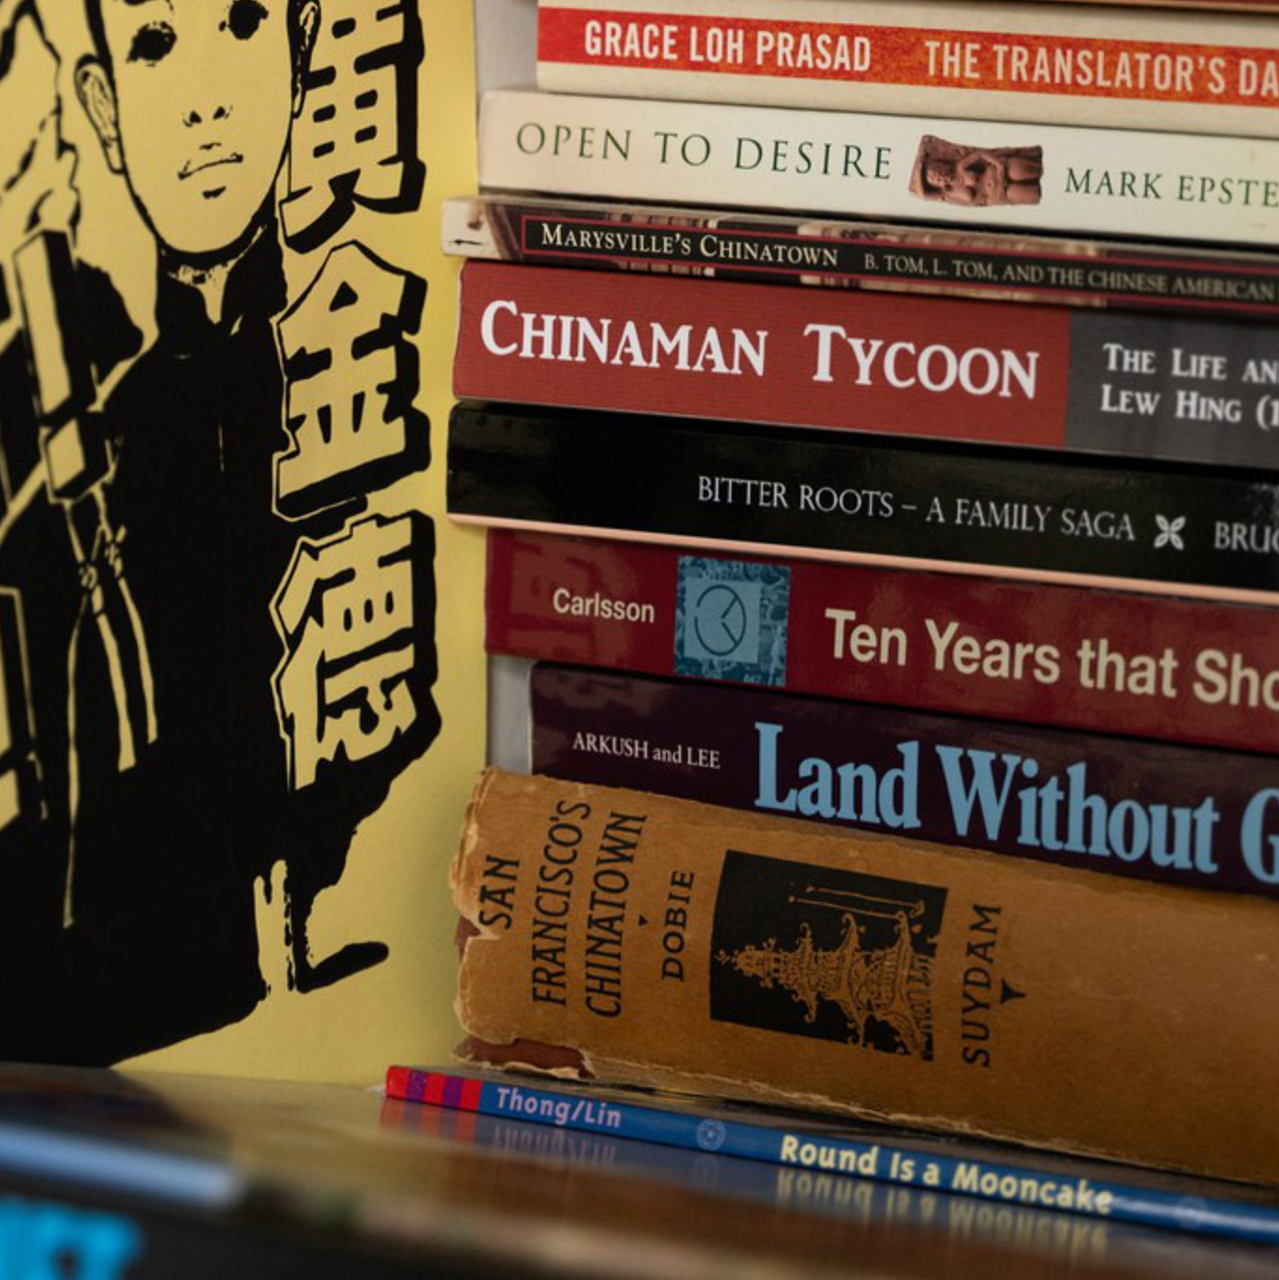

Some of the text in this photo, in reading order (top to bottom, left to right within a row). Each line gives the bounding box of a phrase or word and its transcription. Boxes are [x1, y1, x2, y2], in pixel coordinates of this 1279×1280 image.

[583, 18, 678, 61] GRACE
[688, 25, 746, 66] LOH
[755, 30, 872, 73] PRASAD
[923, 38, 982, 80] THE
[515, 121, 634, 163] OPEN
[654, 129, 714, 168] TO
[734, 136, 894, 181] DESIRE
[1064, 166, 1165, 202] MARK
[698, 233, 840, 268] CHINATOWN
[863, 251, 881, 271] B.
[884, 254, 929, 276] TOM,
[952, 260, 998, 282] TOM,
[1001, 263, 1046, 285] AND
[1049, 266, 1086, 287] THE
[1089, 268, 1167, 296] CHINESE
[1170, 274, 1275, 303] AMERICAN
[480, 298, 1042, 399] CHINAMAN TYCOON
[697, 475, 789, 509] BITTER
[799, 483, 895, 519] ROOTS
[924, 495, 946, 524] A
[954, 498, 1054, 534] FAMILY
[1060, 507, 1137, 543] SAGA
[552, 587, 657, 625] Carlsson
[823, 606, 909, 667] Ten
[923, 618, 1063, 686] Years
[1076, 636, 1180, 698] that
[572, 730, 722, 770] ARKUSH and LEE
[753, 720, 923, 830] Land
[933, 742, 1220, 876] Without
[478, 853, 522, 932] SAN
[584, 809, 649, 1020] CHINATOWN
[660, 868, 697, 984] DOBIE
[960, 902, 1003, 1070] SUYDAM
[496, 1086, 622, 1130] Thong/Lin
[779, 1134, 1115, 1216] Round Is a Mooncake
